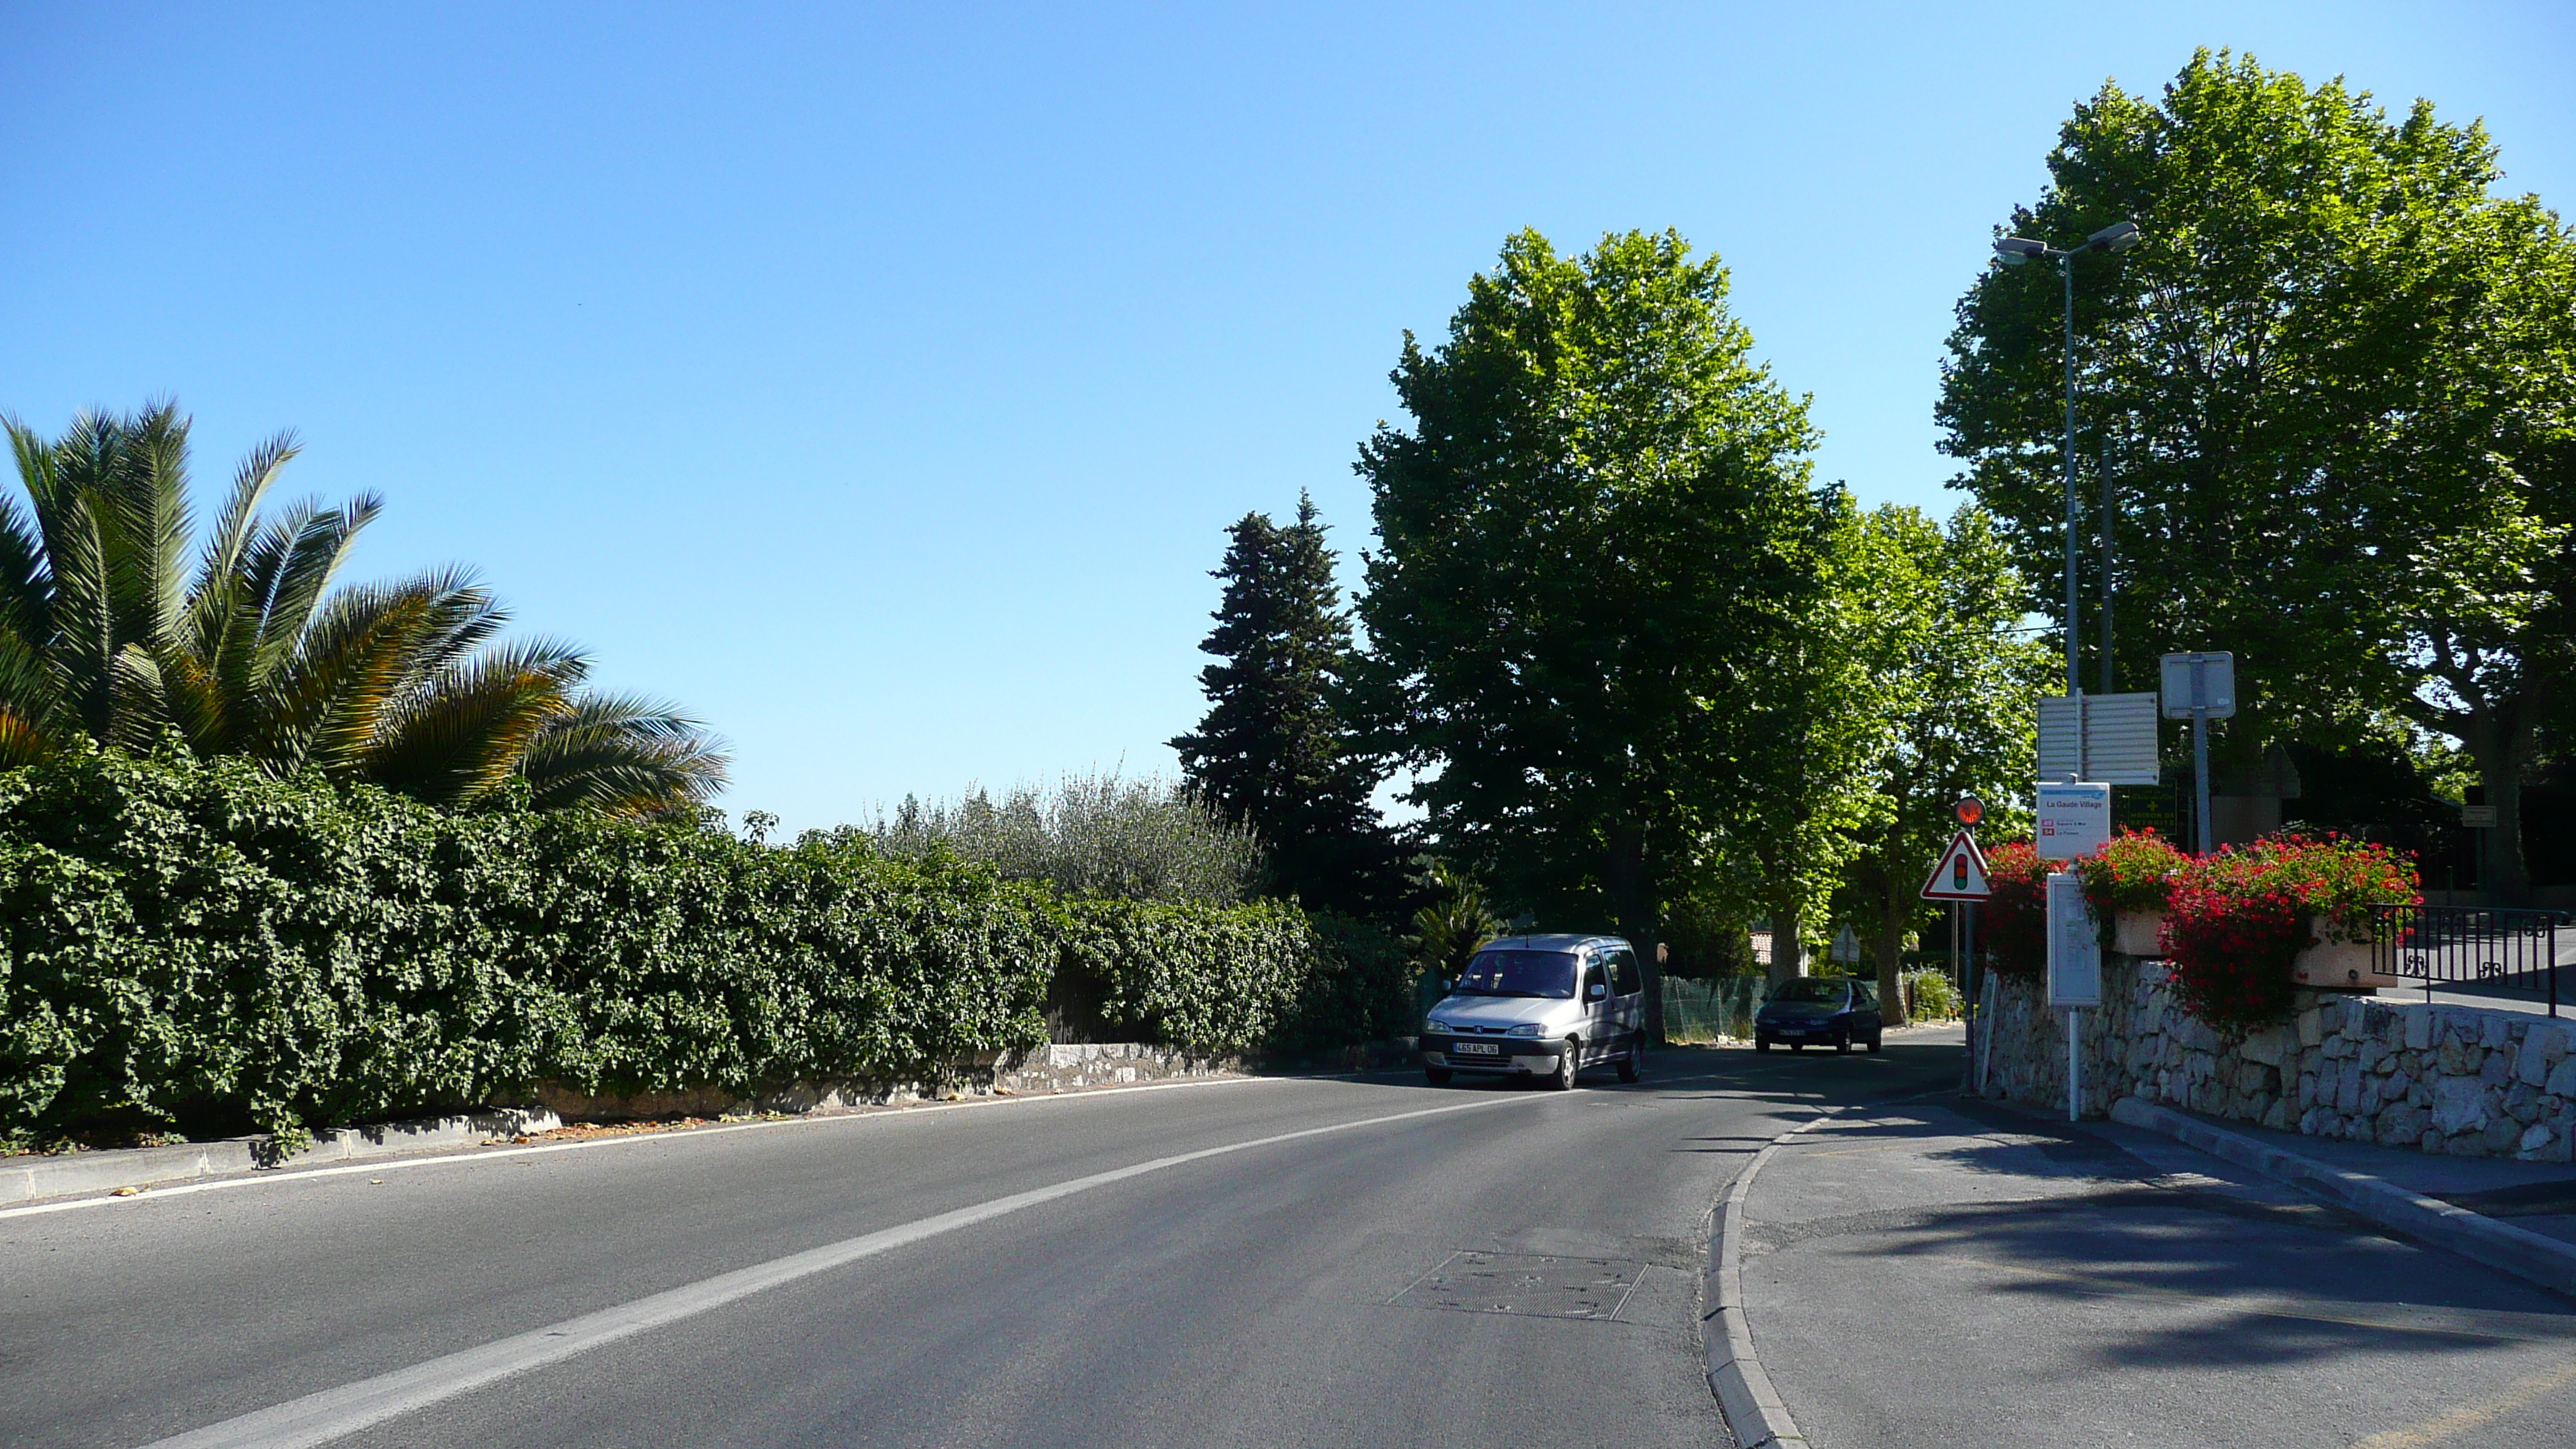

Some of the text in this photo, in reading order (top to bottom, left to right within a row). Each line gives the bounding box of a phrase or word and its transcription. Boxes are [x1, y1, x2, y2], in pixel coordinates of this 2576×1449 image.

[2080, 800, 2102, 809] Village
[1458, 1043, 1497, 1053] 465 APL 06
